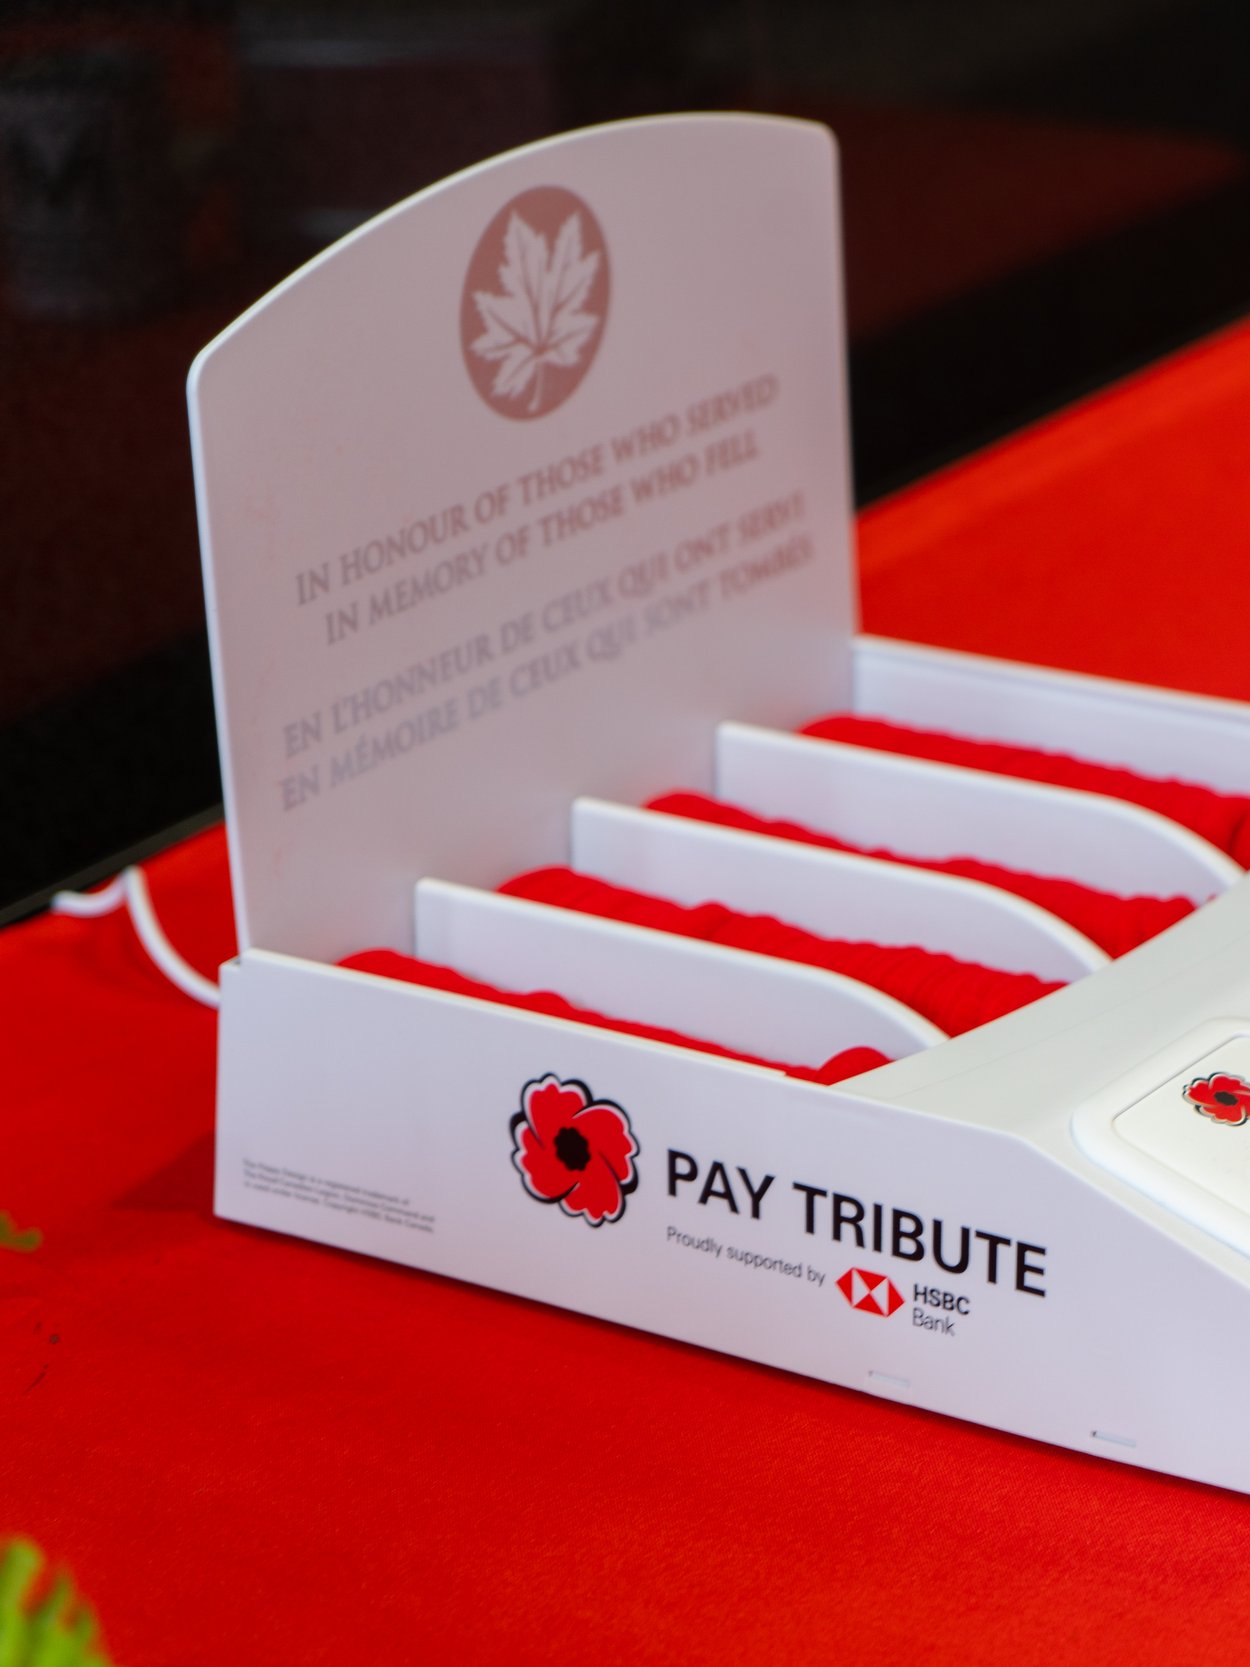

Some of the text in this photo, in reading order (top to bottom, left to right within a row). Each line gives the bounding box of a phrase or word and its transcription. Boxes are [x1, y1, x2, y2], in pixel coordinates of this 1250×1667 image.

[295, 372, 780, 606] IN HONOUR OF THOSE WHO SERVED
[324, 428, 759, 646] IN MEMORY OF THOSE WHO FELL
[281, 764, 321, 813] EN
[329, 697, 461, 789] MÉMOIRE
[465, 675, 503, 720] DE
[508, 639, 582, 698] CEUX
[585, 615, 638, 661] QUI
[642, 578, 711, 636] SONT
[282, 711, 323, 760] EN
[330, 633, 495, 735] L'HONNEUR
[500, 611, 535, 654] DE
[542, 577, 613, 634] CEUX
[618, 551, 670, 599] QUI
[674, 521, 731, 573] ONT
[667, 1148, 1048, 1298] PAY TRIBUTE
[667, 1225, 827, 1288] Proudly supported by
[912, 1283, 971, 1317] HSBC
[912, 1307, 957, 1337] Bank
